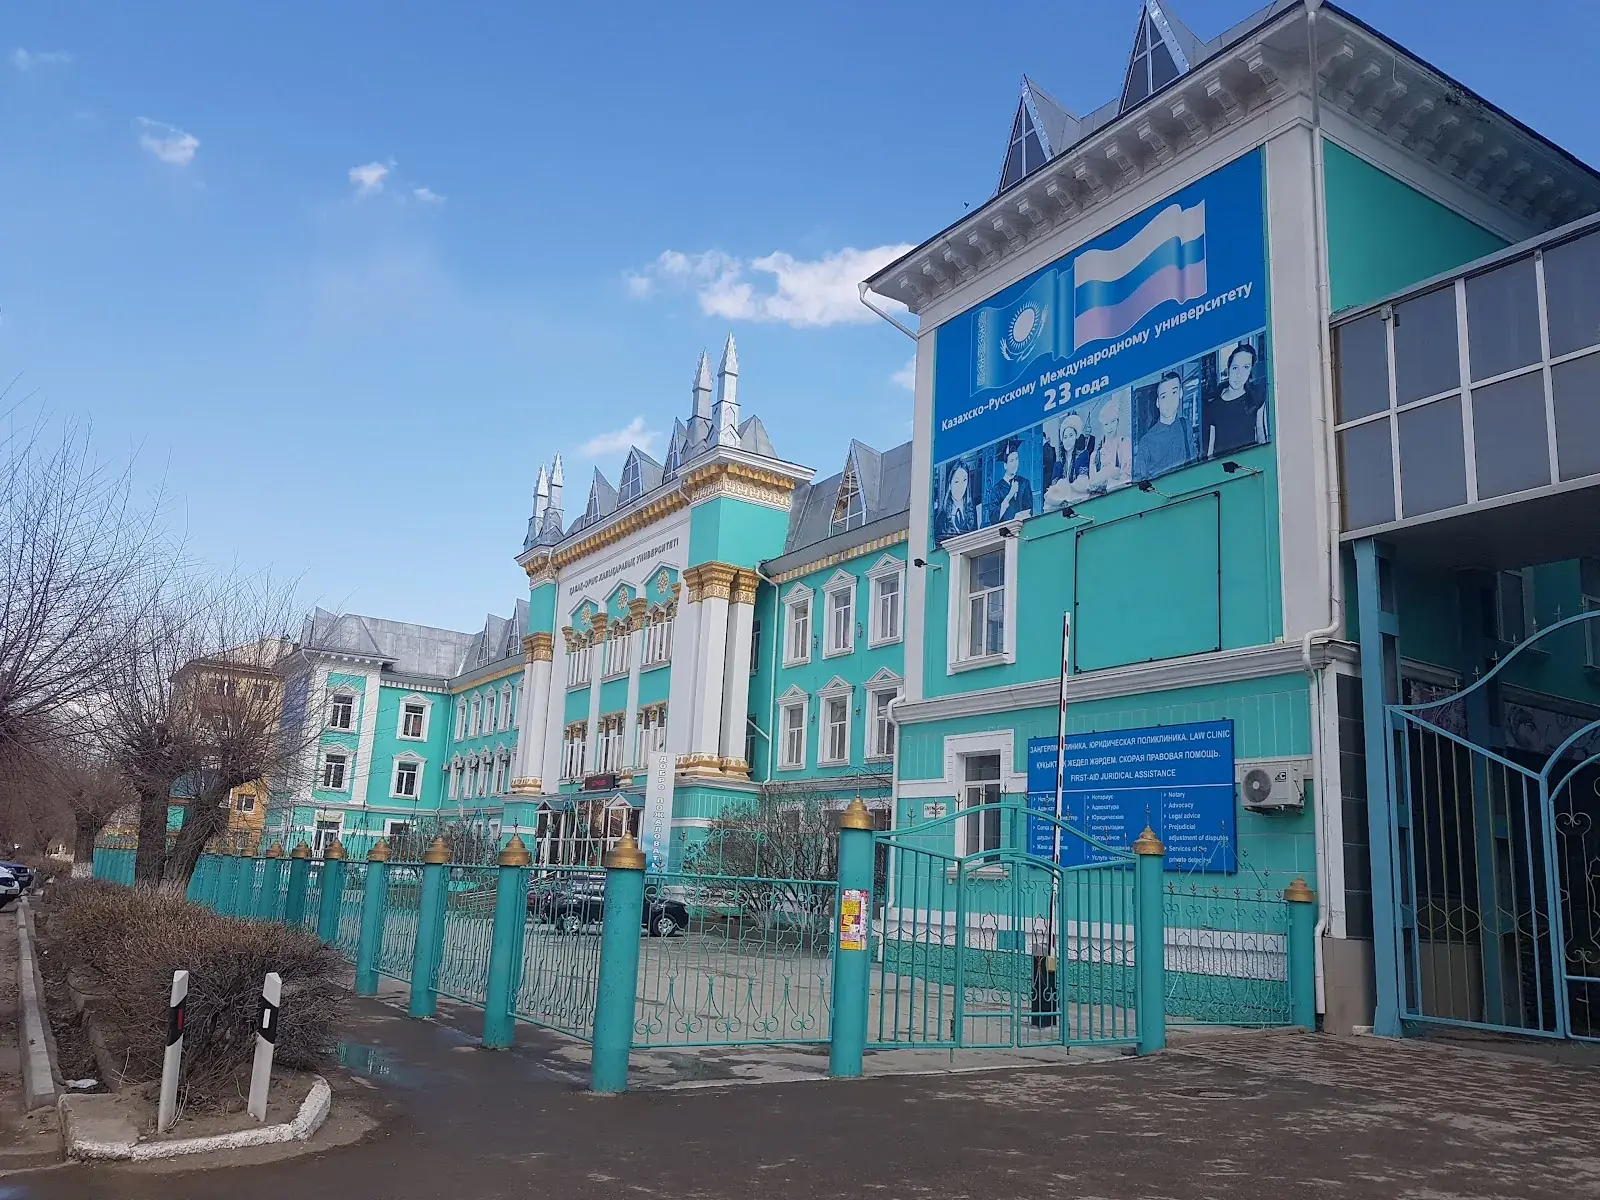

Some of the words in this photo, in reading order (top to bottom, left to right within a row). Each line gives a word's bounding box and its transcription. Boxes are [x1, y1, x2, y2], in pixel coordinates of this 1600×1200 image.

[941, 381, 1037, 432] Казахско-Русскому
[1040, 327, 1150, 386] Международному
[1154, 281, 1253, 339] университету
[1043, 382, 1072, 412] 23
[1074, 374, 1110, 401] года
[1089, 737, 1136, 749] ЮРИДИЧЕСКАЯ
[1137, 733, 1188, 745] ПОЛИКЛИНИКА.
[1189, 731, 1206, 741] LAW
[1206, 729, 1231, 739] CLINIC
[1067, 758, 1089, 768] ЖЕДЕЛ
[1118, 754, 1145, 764] СКОРАЯ
[1146, 751, 1183, 761] ПРАВОВАЯ
[1184, 749, 1221, 759] ПОМОЩЬ.
[1070, 773, 1100, 782] FIRST-AID
[1100, 771, 1133, 781] JURIDICAL
[1134, 769, 1176, 779] ASSISTANCE
[1168, 791, 1186, 799] Notary
[1168, 813, 1182, 821] Legal
[1168, 823, 1196, 831] Prejudicial
[1168, 834, 1198, 842] adjustment
